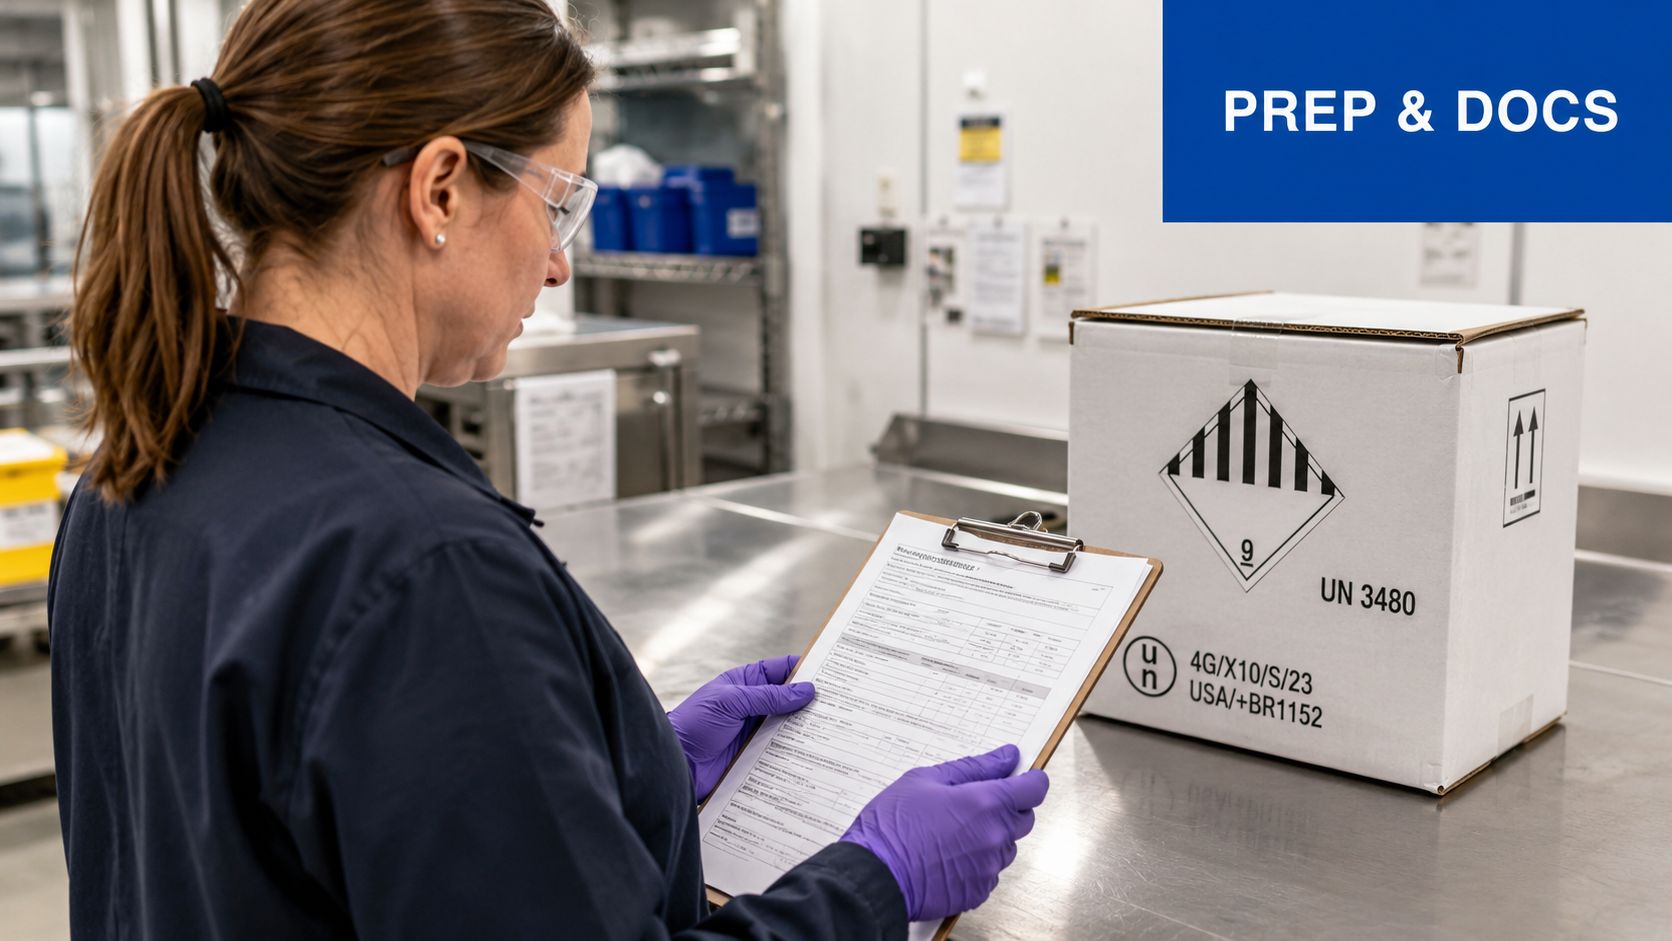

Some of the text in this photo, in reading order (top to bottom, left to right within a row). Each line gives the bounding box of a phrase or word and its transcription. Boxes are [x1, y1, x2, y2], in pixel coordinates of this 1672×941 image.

[1241, 538, 1254, 562] 9
[1320, 576, 1416, 617] UN 3480
[1189, 650, 1313, 696] 4G/X10/S/23
[1189, 679, 1323, 729] USA/+BR1152
